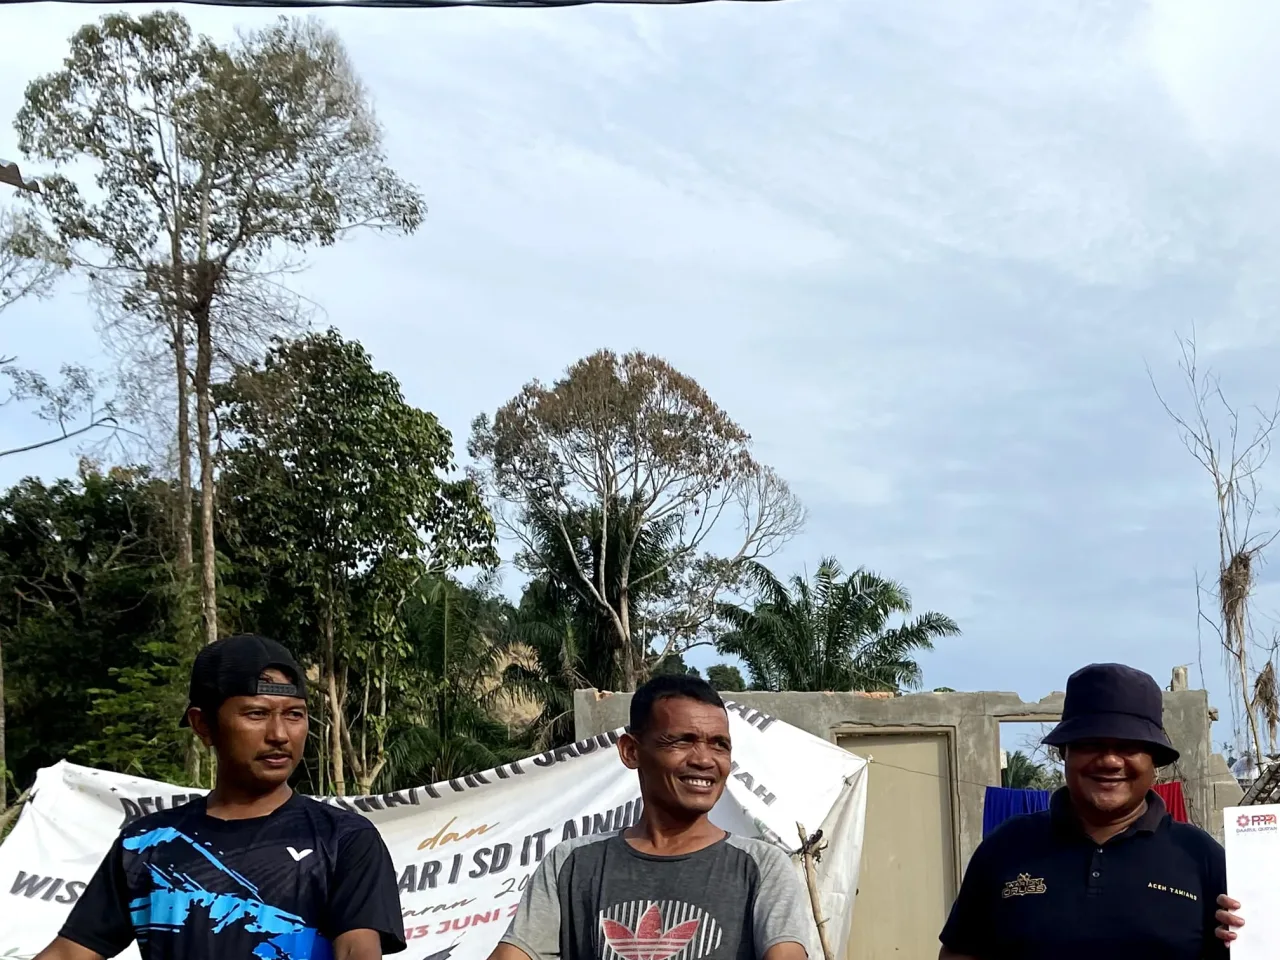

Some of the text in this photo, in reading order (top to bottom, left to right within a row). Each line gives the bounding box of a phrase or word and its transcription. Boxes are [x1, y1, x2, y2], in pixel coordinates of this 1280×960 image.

[416, 816, 500, 851] dan
[396, 859, 441, 894] AR
[469, 842, 513, 879] SD
[519, 828, 554, 867] IT
[9, 870, 88, 905] WIS
[400, 896, 477, 919] aran
[435, 907, 501, 934] JUNI
